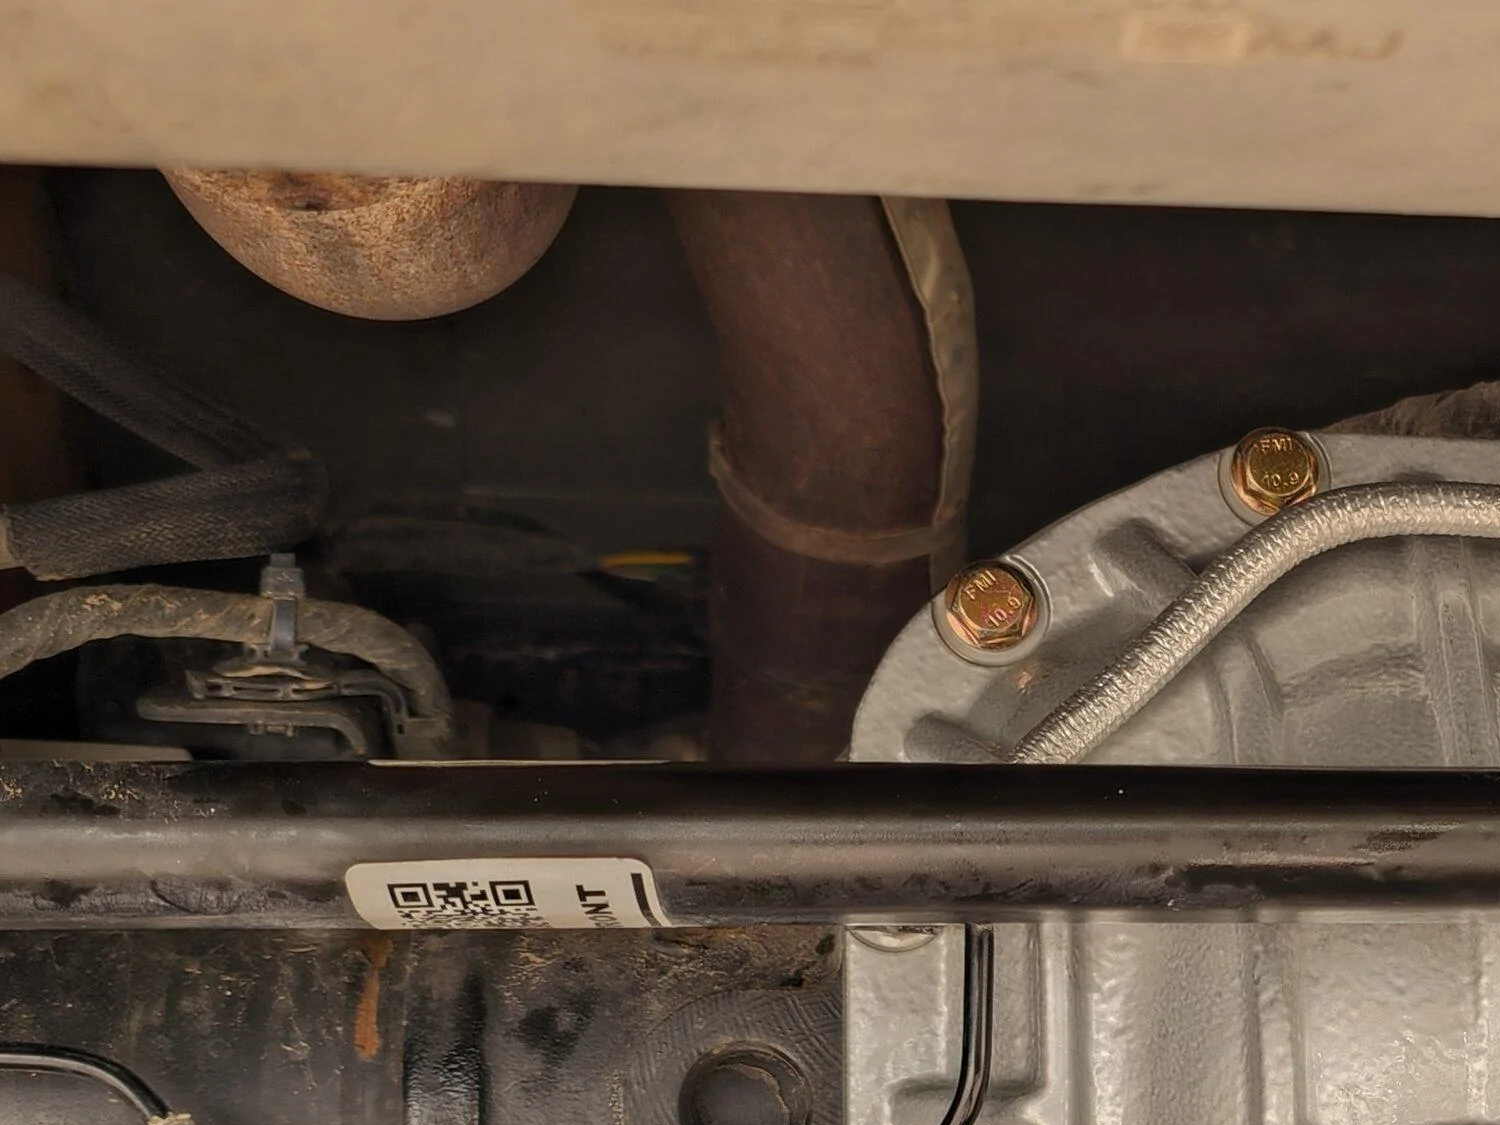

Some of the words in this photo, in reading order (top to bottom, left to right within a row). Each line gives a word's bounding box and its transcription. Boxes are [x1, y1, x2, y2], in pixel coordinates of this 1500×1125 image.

[1259, 437, 1294, 455] FMI
[1261, 472, 1300, 488] 10.9
[963, 569, 997, 600] FMI
[985, 596, 1022, 627] 10.9
